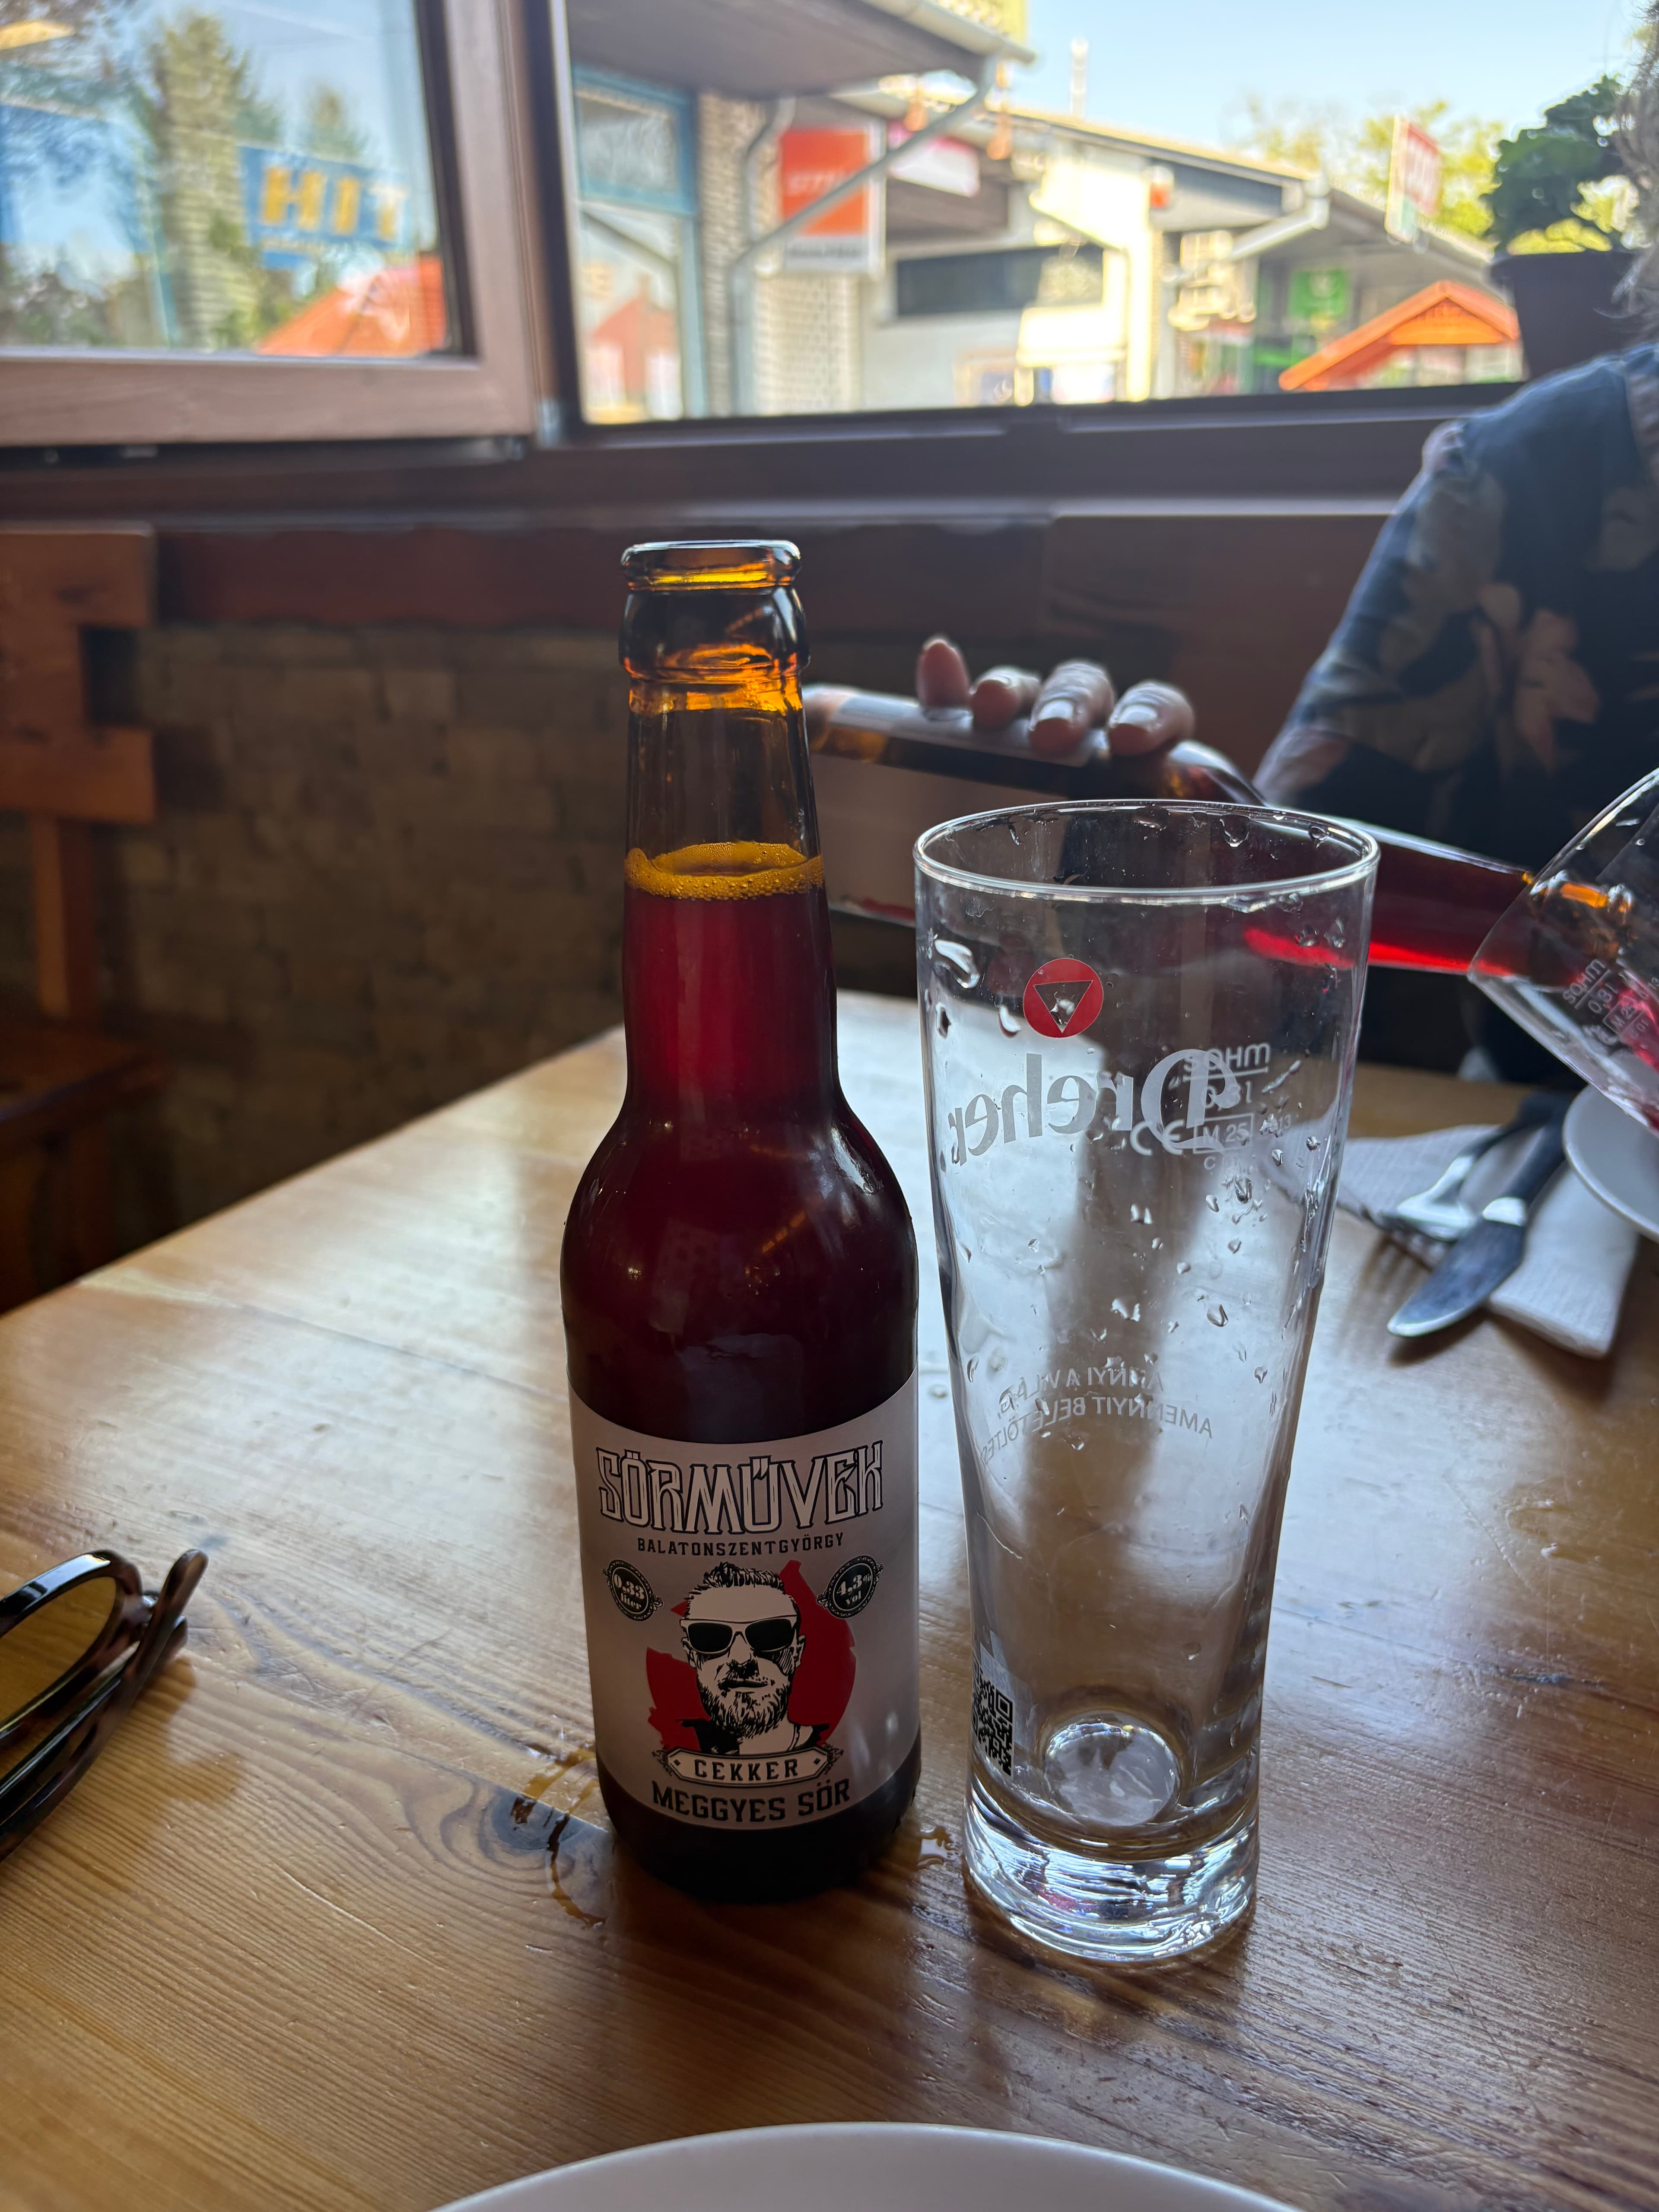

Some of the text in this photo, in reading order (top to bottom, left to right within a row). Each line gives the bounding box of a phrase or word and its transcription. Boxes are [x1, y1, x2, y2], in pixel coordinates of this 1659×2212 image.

[596, 1440, 883, 1535] SÖRMŰVEK
[637, 1532, 843, 1556] BALATONSZENTGYÖRGY
[614, 1574, 645, 1599] 0,33
[845, 1586, 861, 1605] vol
[621, 1592, 642, 1610] liter
[694, 1758, 798, 1781] CEKKER
[652, 1778, 850, 1822] MEGGYES SÖR
